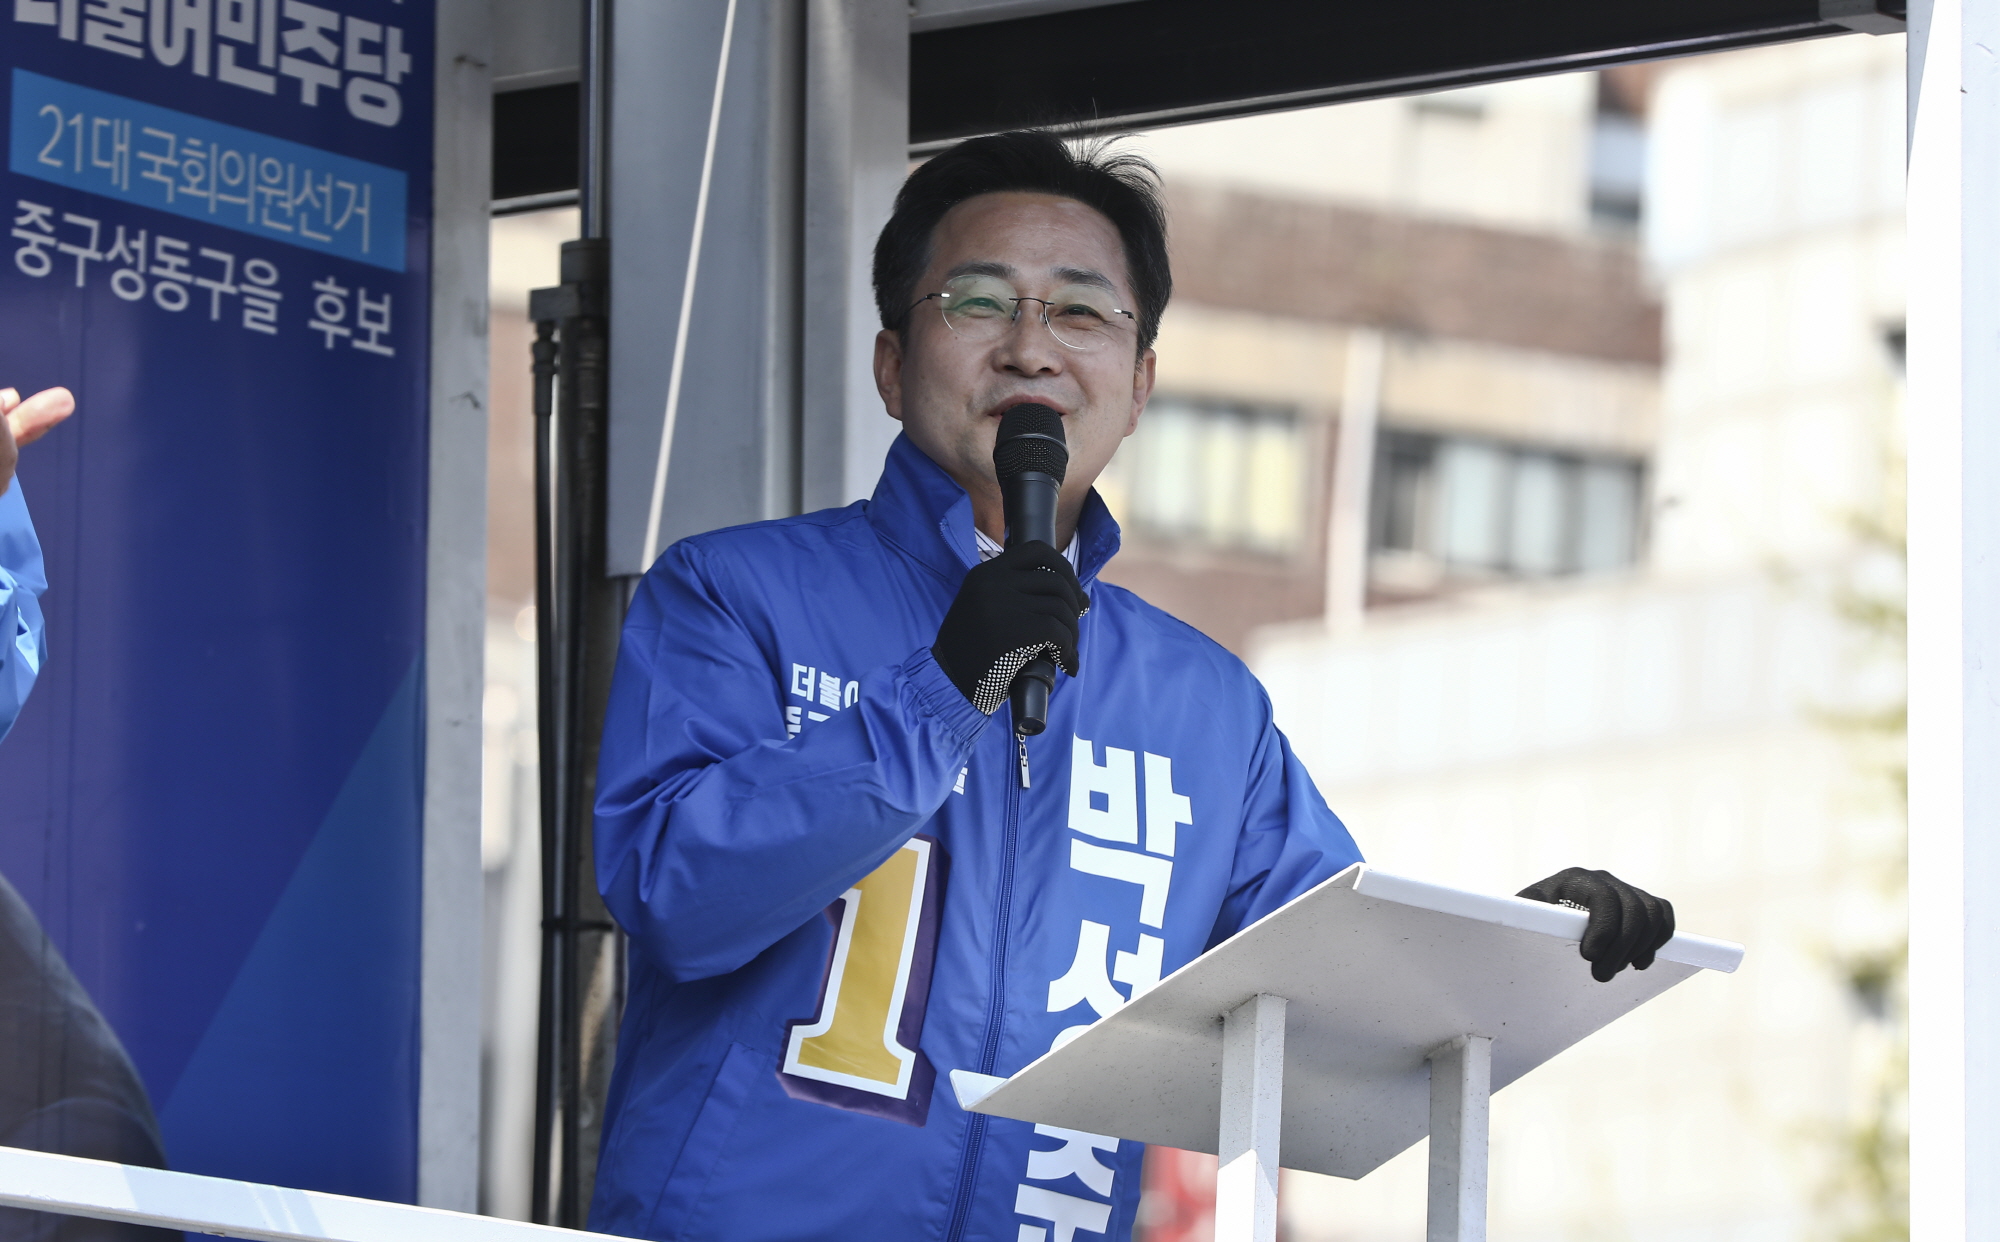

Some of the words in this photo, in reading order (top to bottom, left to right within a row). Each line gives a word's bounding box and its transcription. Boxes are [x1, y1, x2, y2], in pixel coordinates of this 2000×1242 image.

[11, 199, 283, 335] 중구성동구을
[307, 275, 396, 357] 후보
[781, 836, 932, 1101] 1
